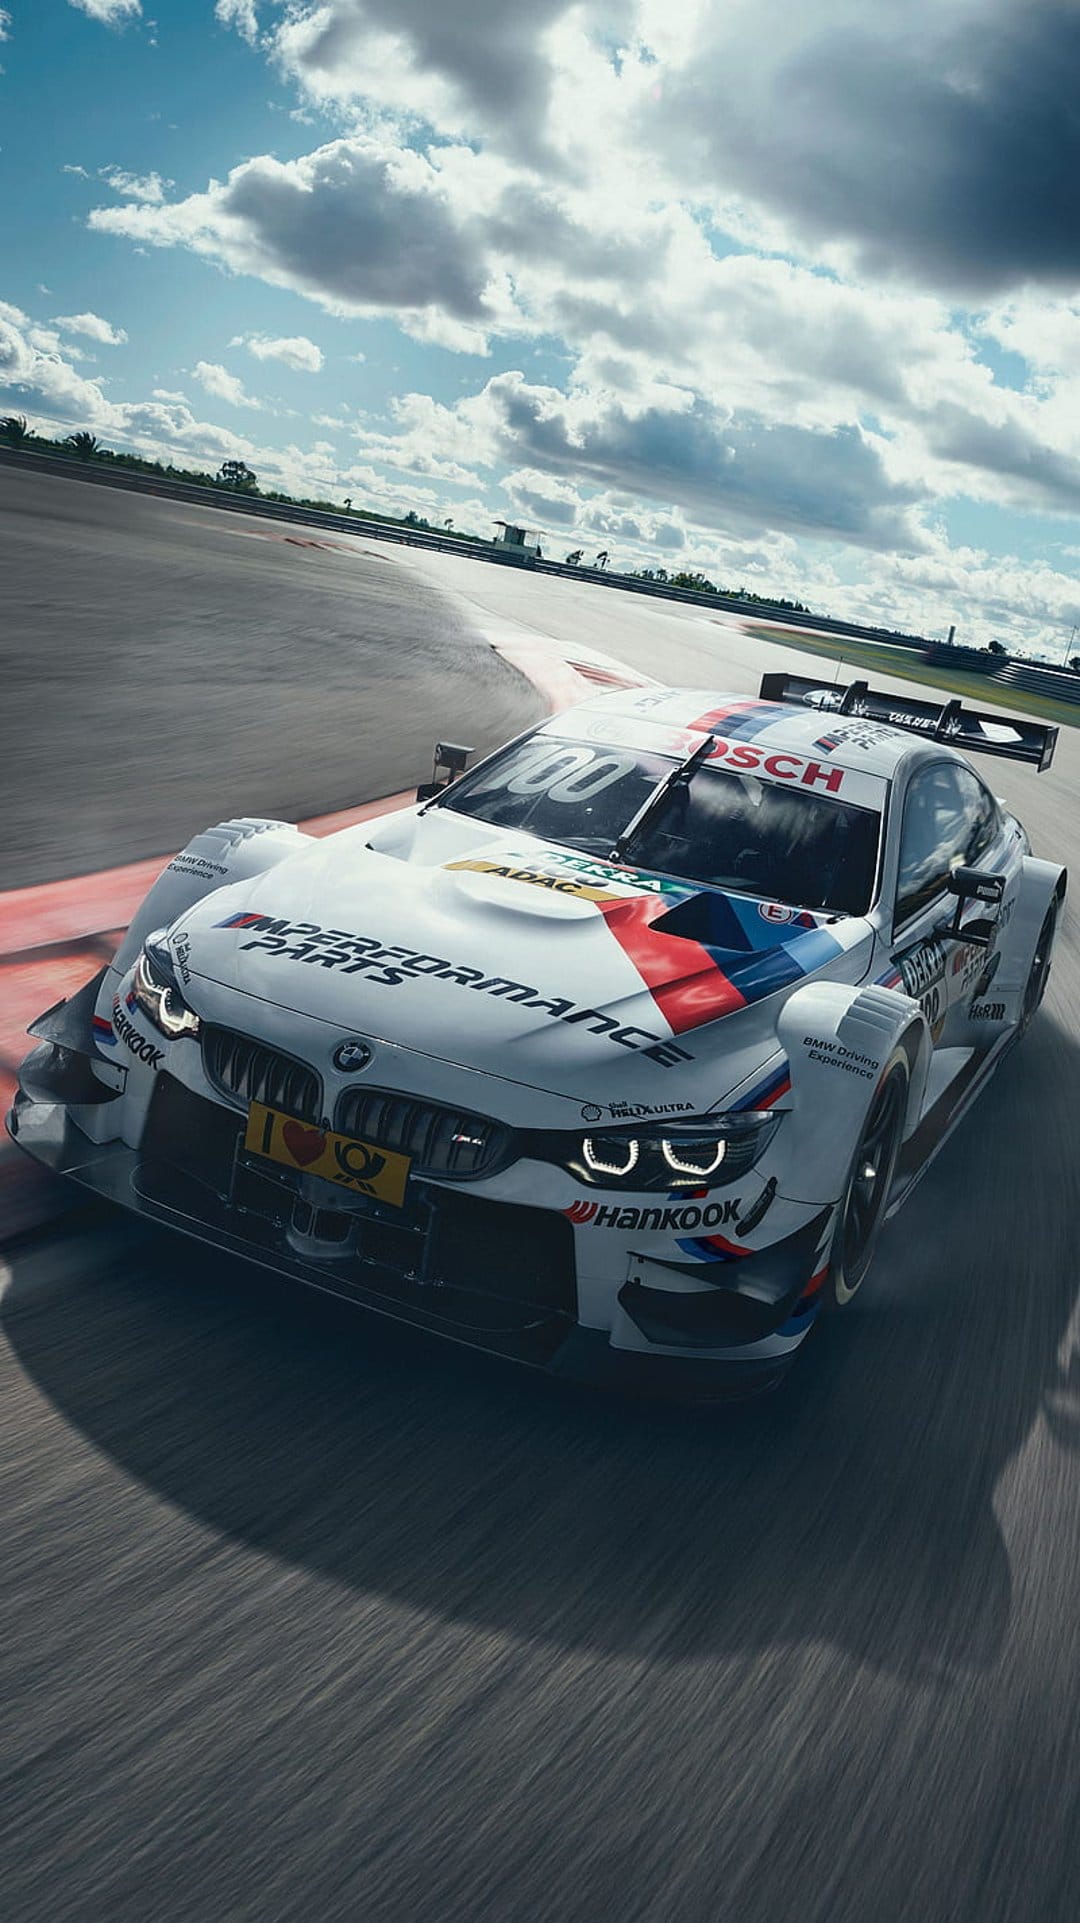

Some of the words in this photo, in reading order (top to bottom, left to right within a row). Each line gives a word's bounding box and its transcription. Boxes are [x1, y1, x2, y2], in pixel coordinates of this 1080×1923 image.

[482, 744, 637, 803] 100
[665, 732, 845, 793] BOSCH
[167, 863, 214, 879] Experience
[197, 859, 229, 875] Driving
[483, 866, 582, 893] ADAC
[538, 852, 662, 892] DEKRA
[767, 905, 782, 919] E
[239, 936, 420, 986] PARTS
[803, 1037, 836, 1052] BMW
[837, 1046, 880, 1069] Driving
[808, 1049, 874, 1080] Experience
[652, 1102, 695, 1114] ULTRA
